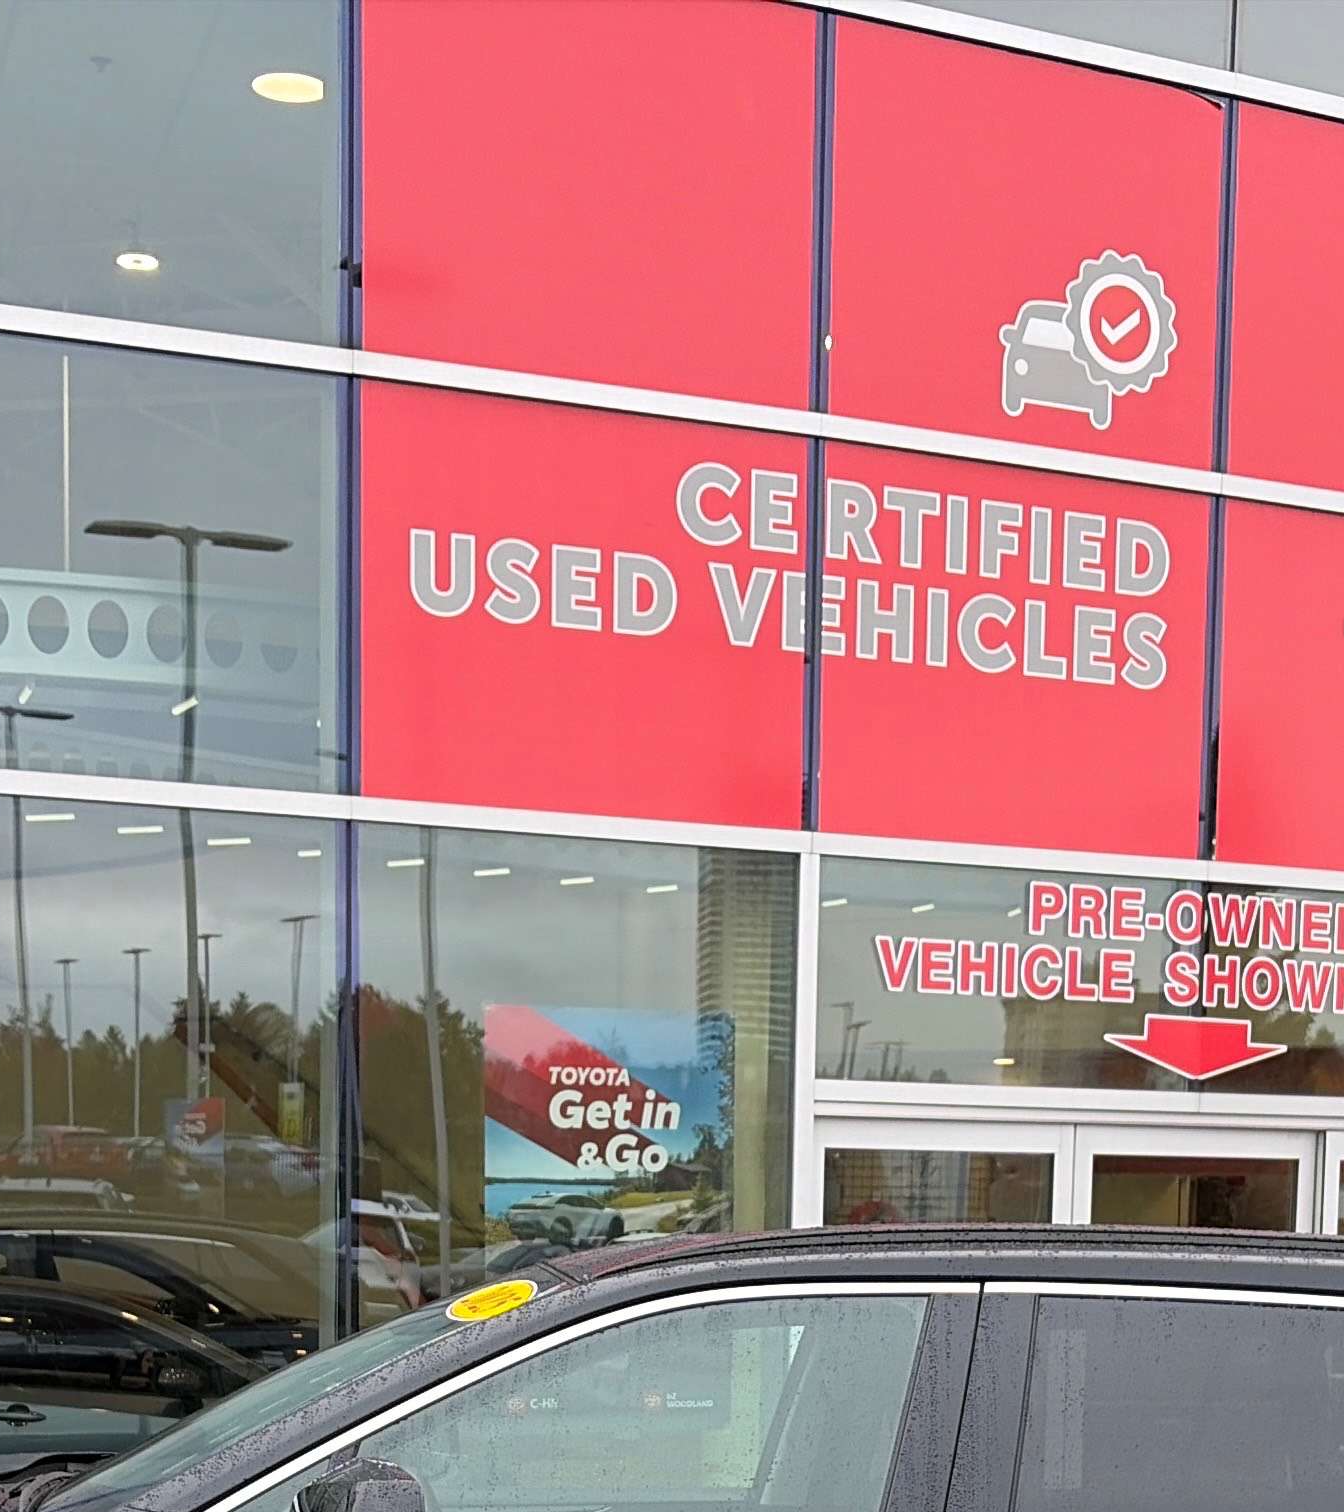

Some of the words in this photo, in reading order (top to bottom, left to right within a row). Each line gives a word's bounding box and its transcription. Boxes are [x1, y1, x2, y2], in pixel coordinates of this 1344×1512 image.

[676, 461, 1171, 597] CERTIFIED
[409, 528, 678, 637] USED
[708, 560, 1168, 691] VEHICLES
[875, 935, 1135, 1004] VEHICLE
[548, 1066, 631, 1086] TOYOTA
[549, 1089, 632, 1130] Get
[640, 1089, 681, 1130] in
